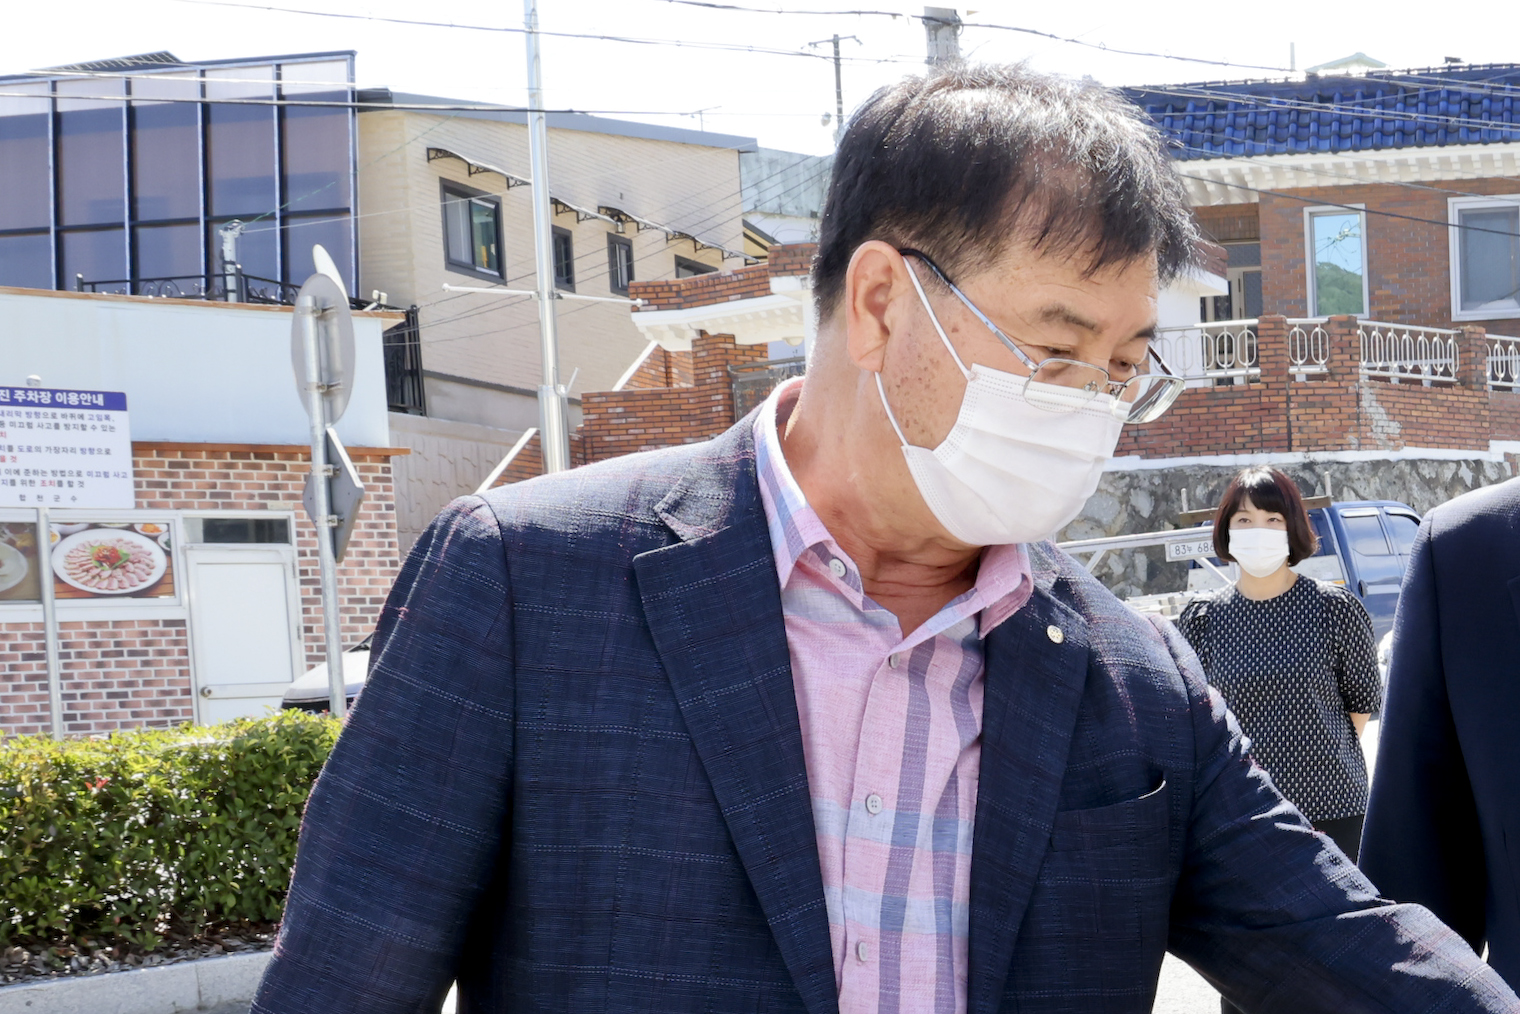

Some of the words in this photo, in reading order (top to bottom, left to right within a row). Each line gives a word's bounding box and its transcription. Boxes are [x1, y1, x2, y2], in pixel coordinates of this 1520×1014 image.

[14, 390, 52, 404] 주차장
[55, 392, 104, 406] 이용안내
[25, 411, 58, 420] 방향으로
[60, 413, 85, 421] 바퀴에
[63, 423, 88, 431] 방지할
[90, 424, 97, 432] 수
[17, 445, 42, 453] 도로의
[45, 446, 77, 454] 가장자리
[80, 447, 112, 455] 방향으로
[5, 468, 20, 476] 이에
[51, 469, 83, 478] 방법으로
[20, 479, 35, 487] 위한
[1197, 542, 1214, 553] 686
